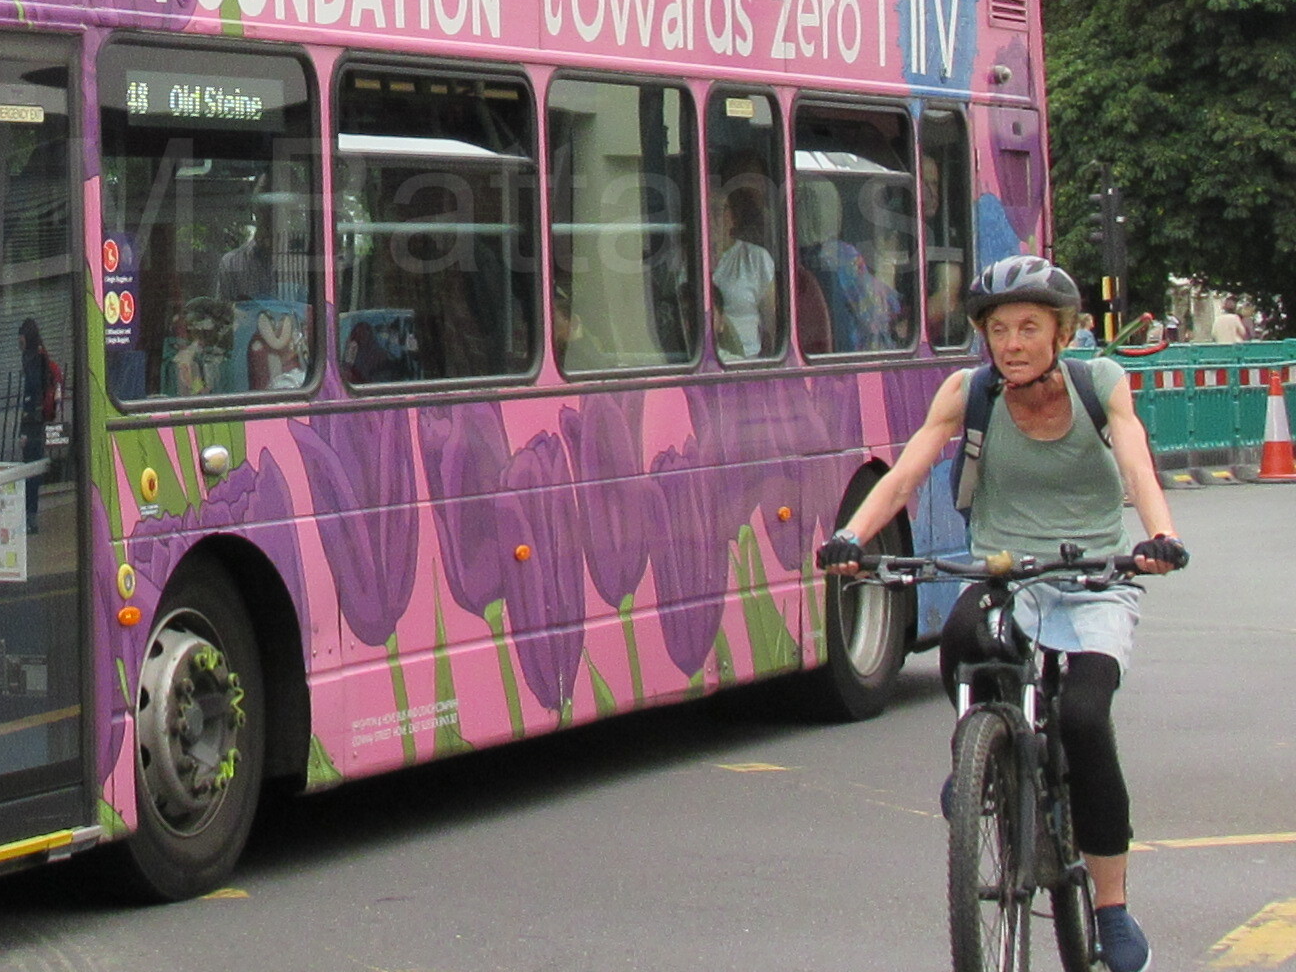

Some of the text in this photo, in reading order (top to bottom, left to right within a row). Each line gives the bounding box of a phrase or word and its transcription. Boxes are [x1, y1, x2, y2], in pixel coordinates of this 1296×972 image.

[127, 81, 262, 120] 48 Old Steine
